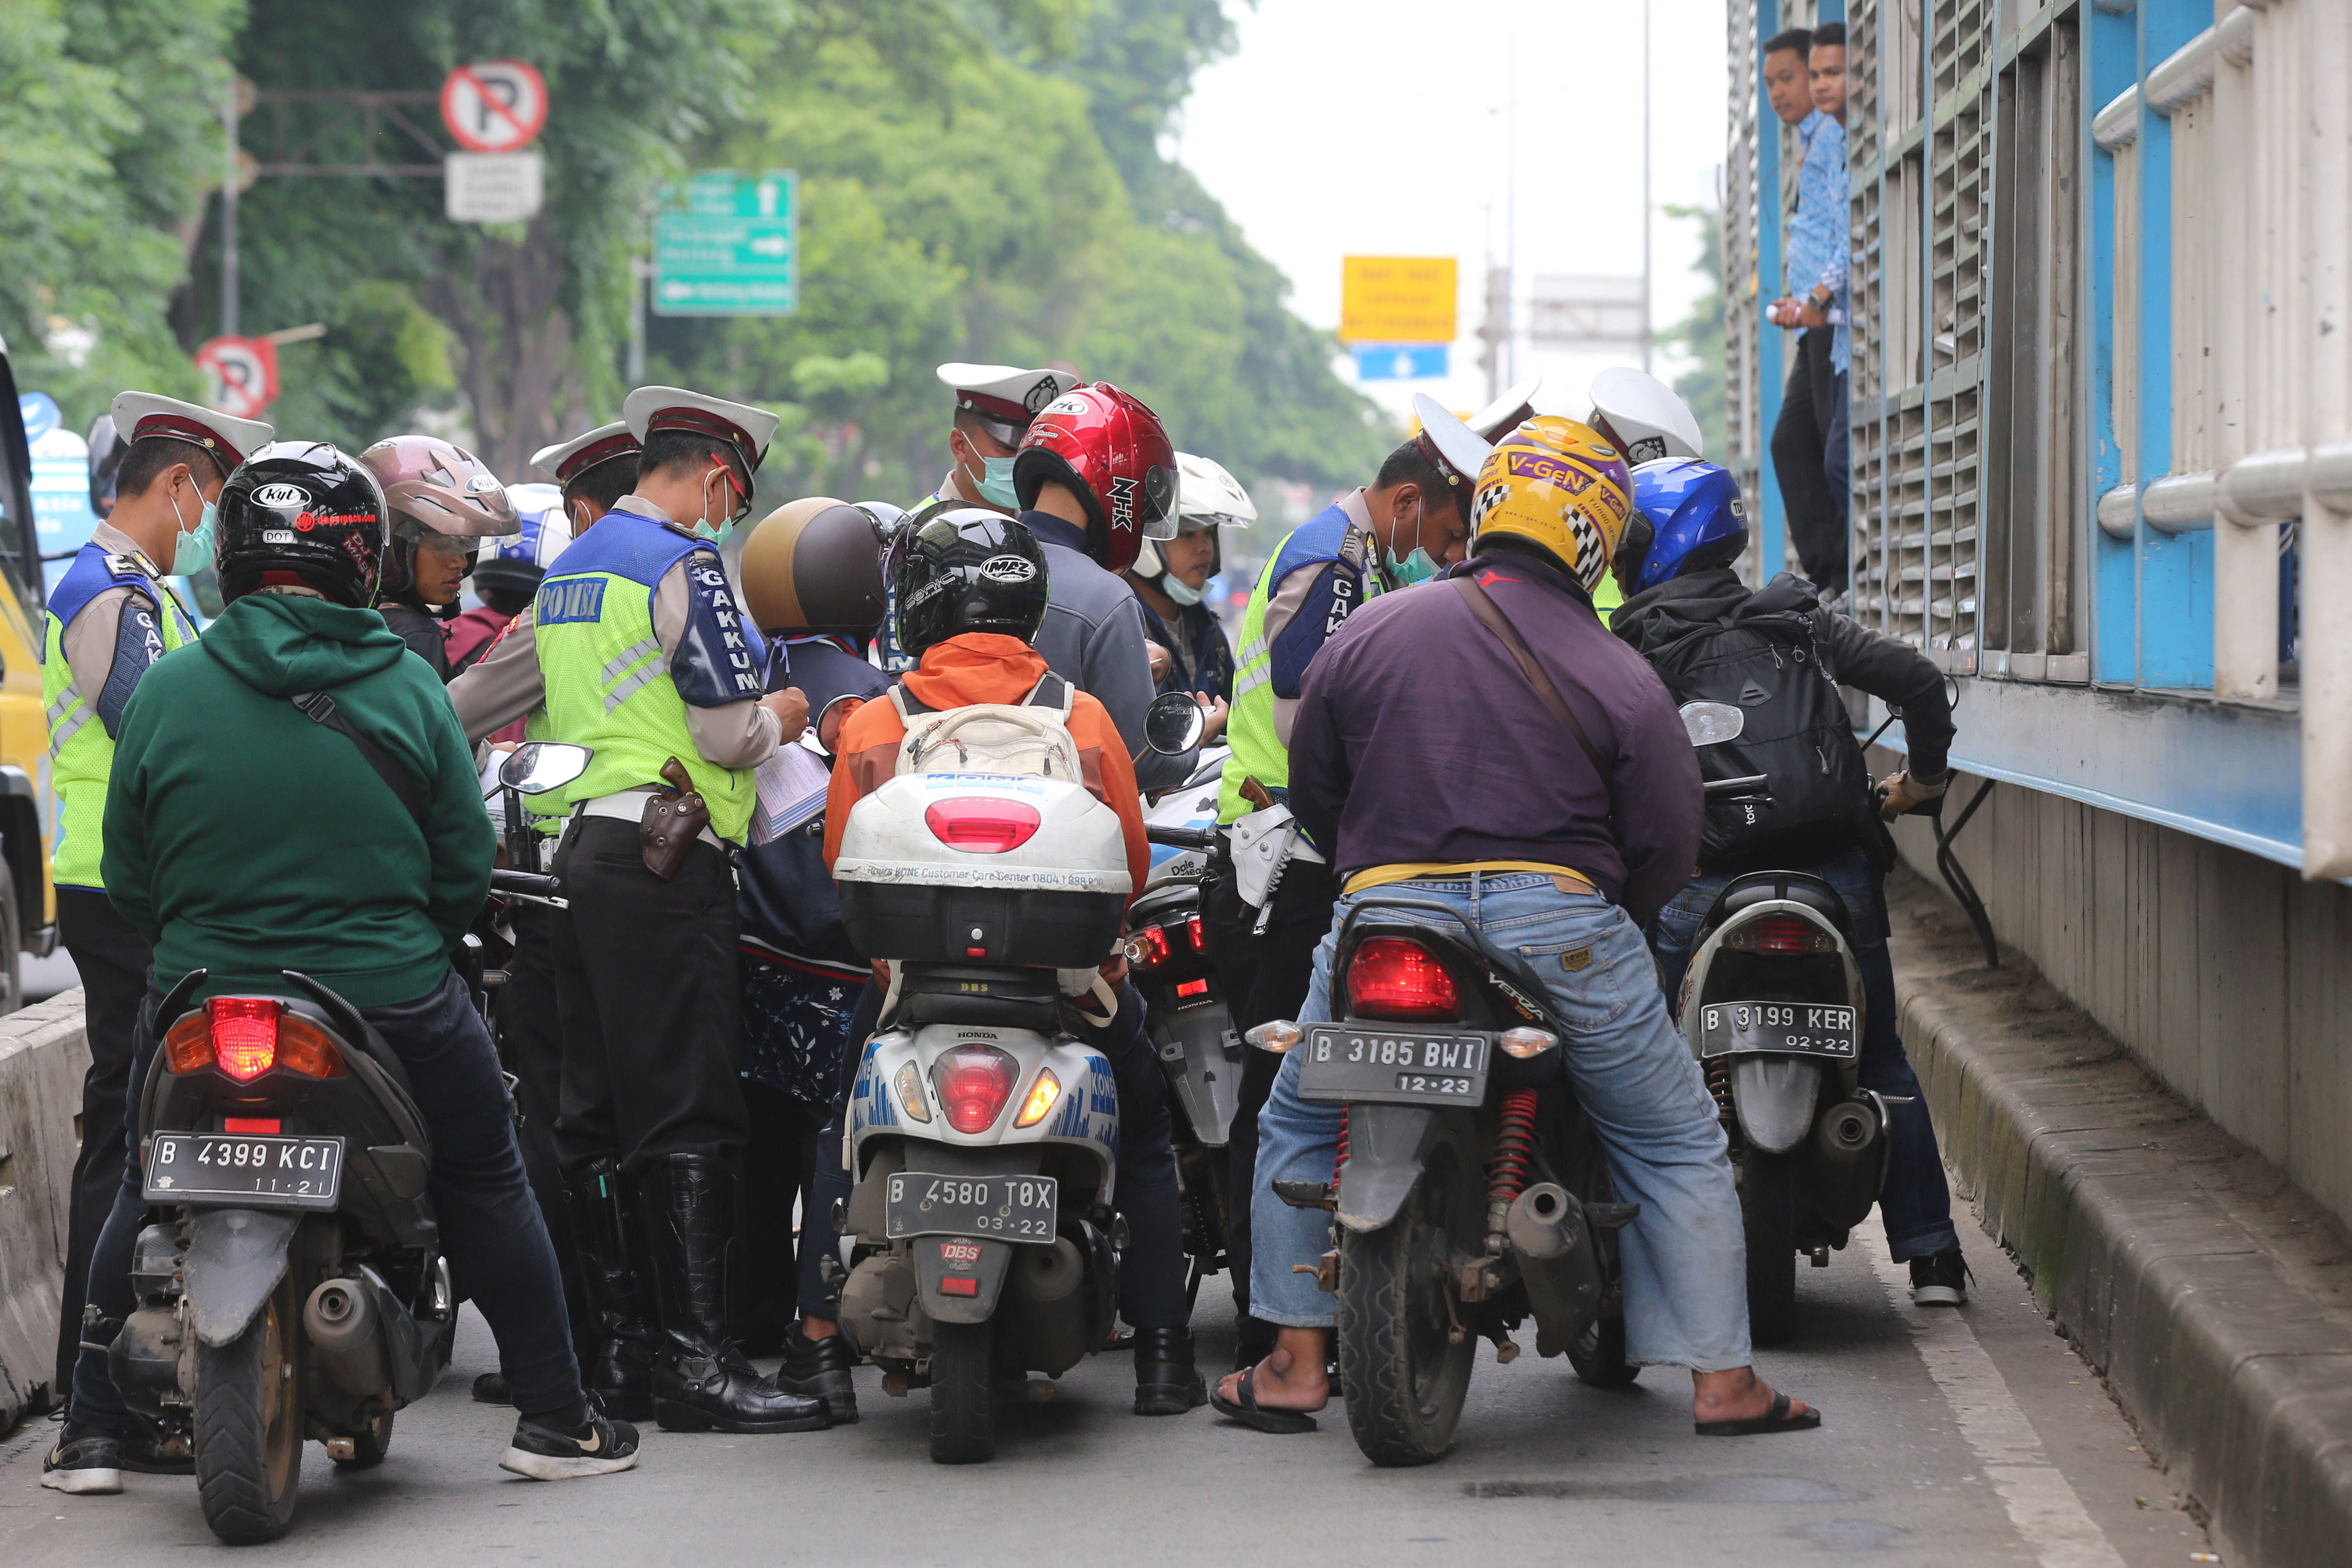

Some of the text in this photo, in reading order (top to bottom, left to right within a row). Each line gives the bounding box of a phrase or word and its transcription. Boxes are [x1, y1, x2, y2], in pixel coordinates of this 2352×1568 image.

[1105, 476, 1139, 533] NHK
[266, 532, 290, 541] DOT
[988, 560, 1031, 575] MAZ
[701, 570, 760, 691] GAKKUM
[1744, 805, 1756, 825] torc
[895, 867, 920, 877] KONE
[922, 868, 969, 879] Customer
[1033, 873, 1059, 883] 0804
[1171, 860, 1195, 877] Dale
[960, 983, 988, 992] DBS
[1489, 971, 1544, 1021] VERZA
[1177, 999, 1214, 1011] HONDA
[1706, 1006, 1852, 1031] B 3199 KER
[1316, 1036, 1475, 1069] B 3185 BWI
[1091, 1071, 1118, 1100] KONE
[160, 1141, 330, 1171] B 4399 KCI
[890, 1179, 904, 1203] B
[926, 1180, 988, 1206] 4580
[944, 1245, 979, 1260] DBS
